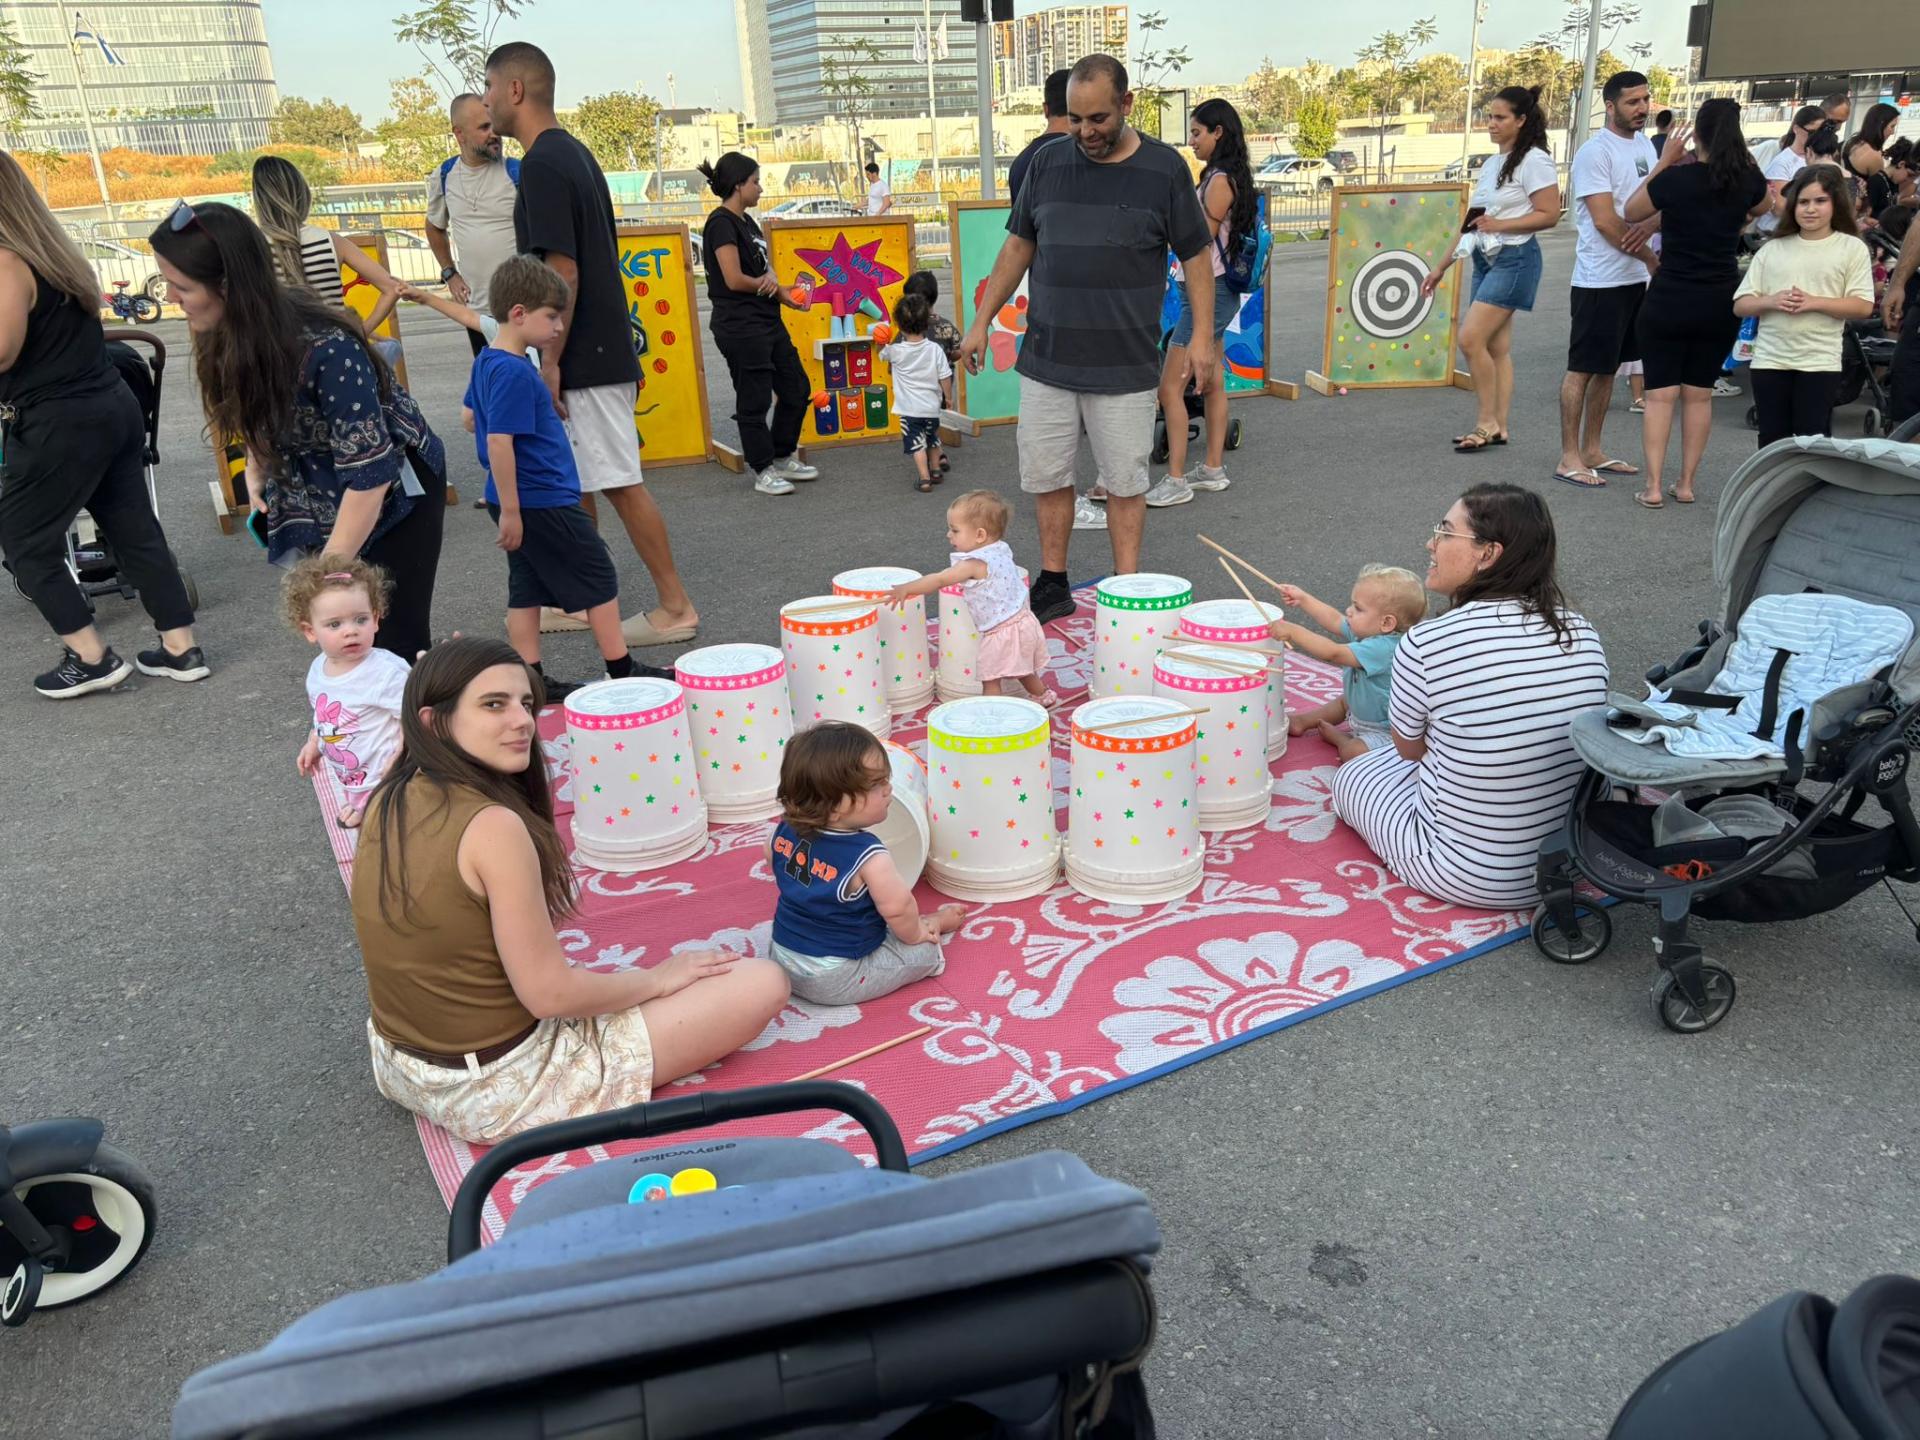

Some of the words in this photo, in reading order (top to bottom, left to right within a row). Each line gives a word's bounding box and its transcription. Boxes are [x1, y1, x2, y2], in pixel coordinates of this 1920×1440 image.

[815, 255, 849, 286] POP
[1879, 757, 1898, 771] baby
[632, 1142, 737, 1164] easywalker
